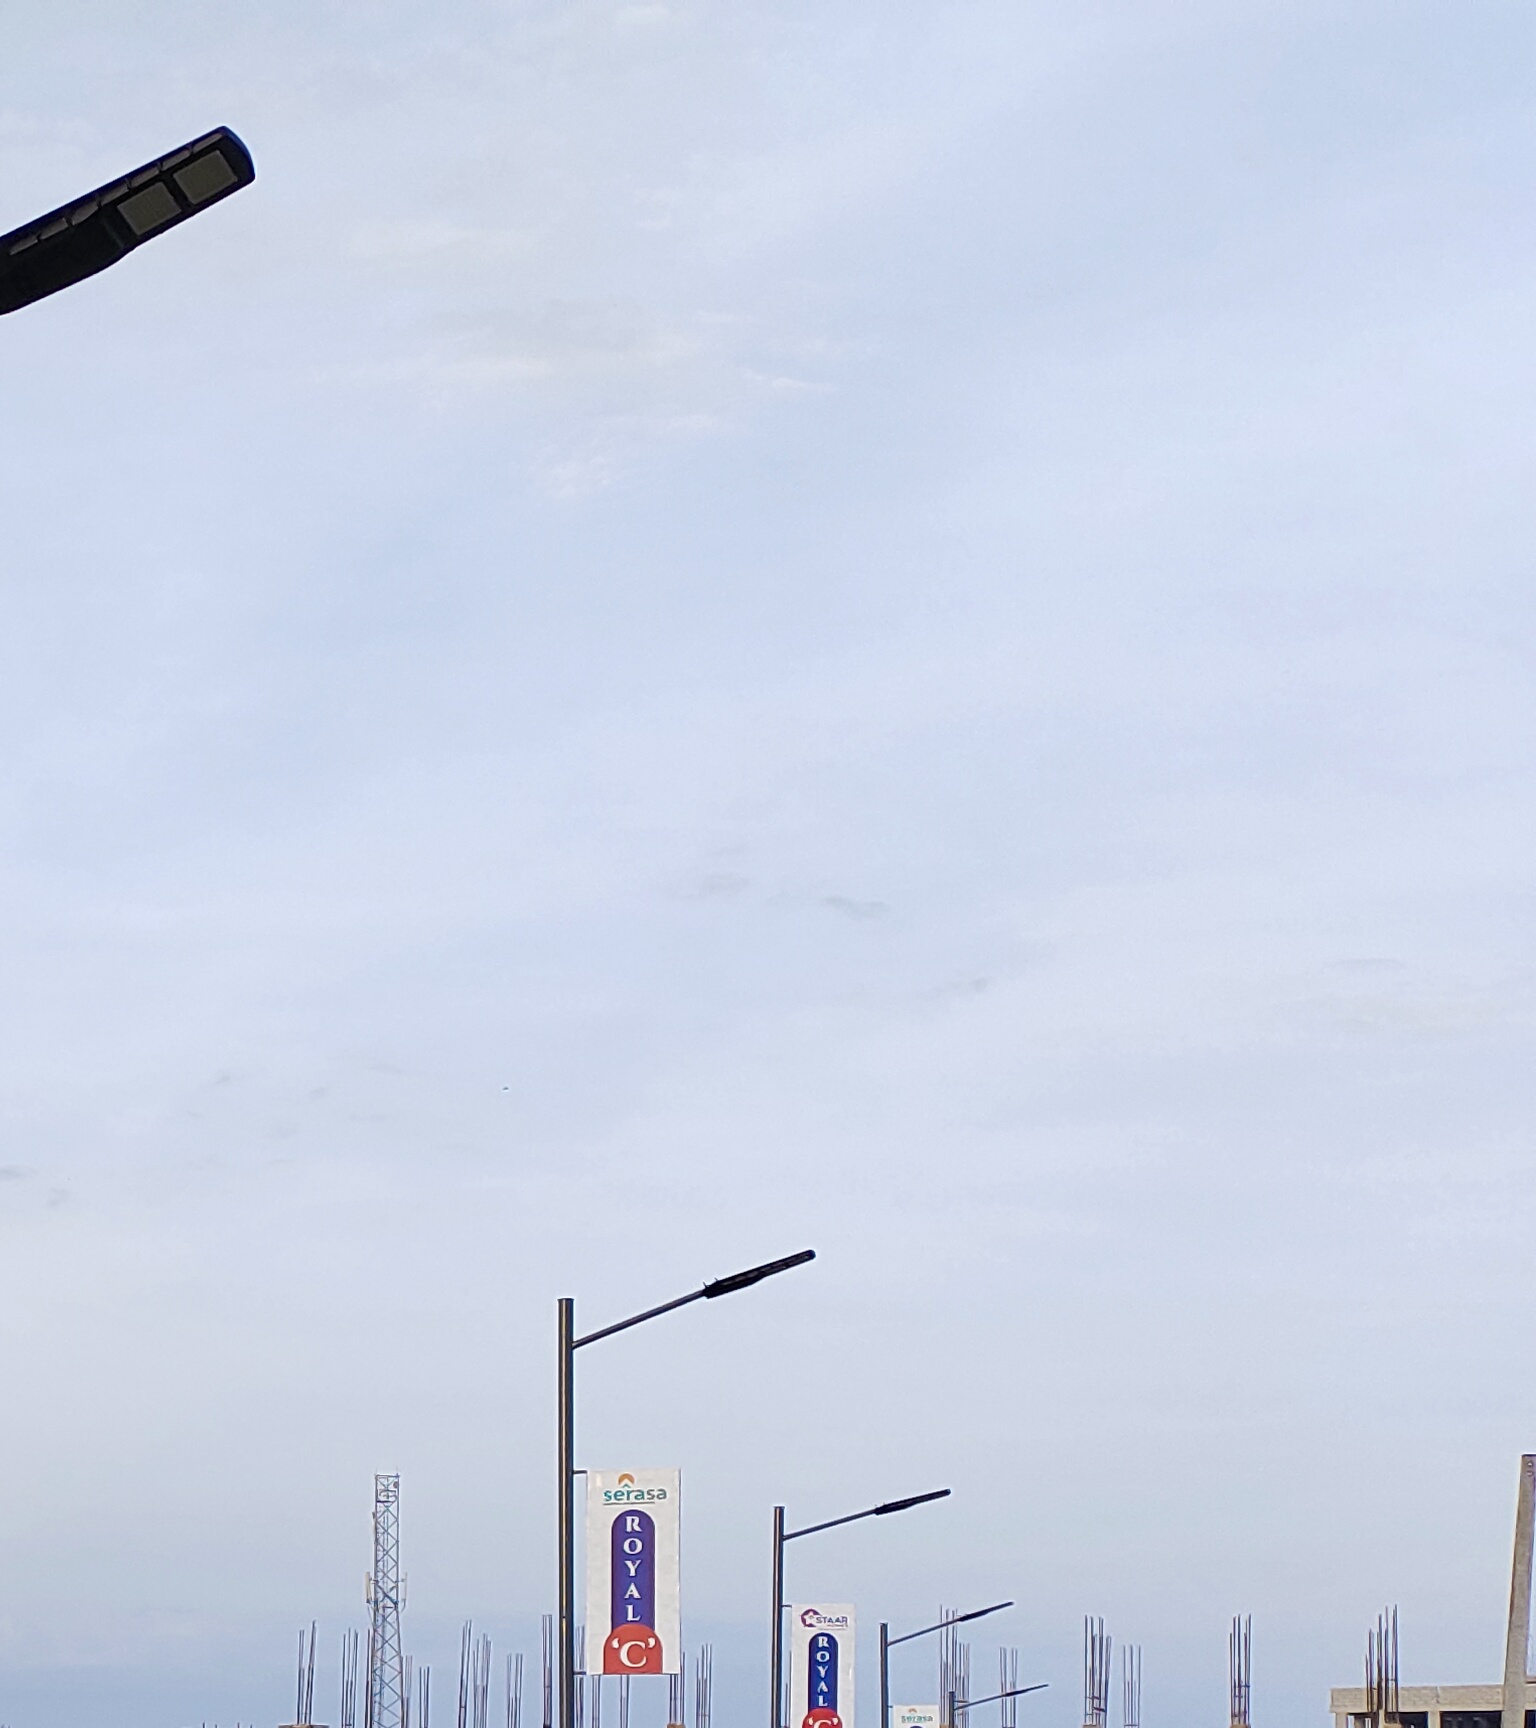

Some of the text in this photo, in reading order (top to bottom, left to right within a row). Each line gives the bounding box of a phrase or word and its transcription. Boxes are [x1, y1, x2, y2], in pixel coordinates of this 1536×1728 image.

[603, 1487, 667, 1502] serasa
[623, 1516, 642, 1622] ROYAL
[816, 1616, 848, 1624] STAAR
[816, 1636, 830, 1707] ROYAL
